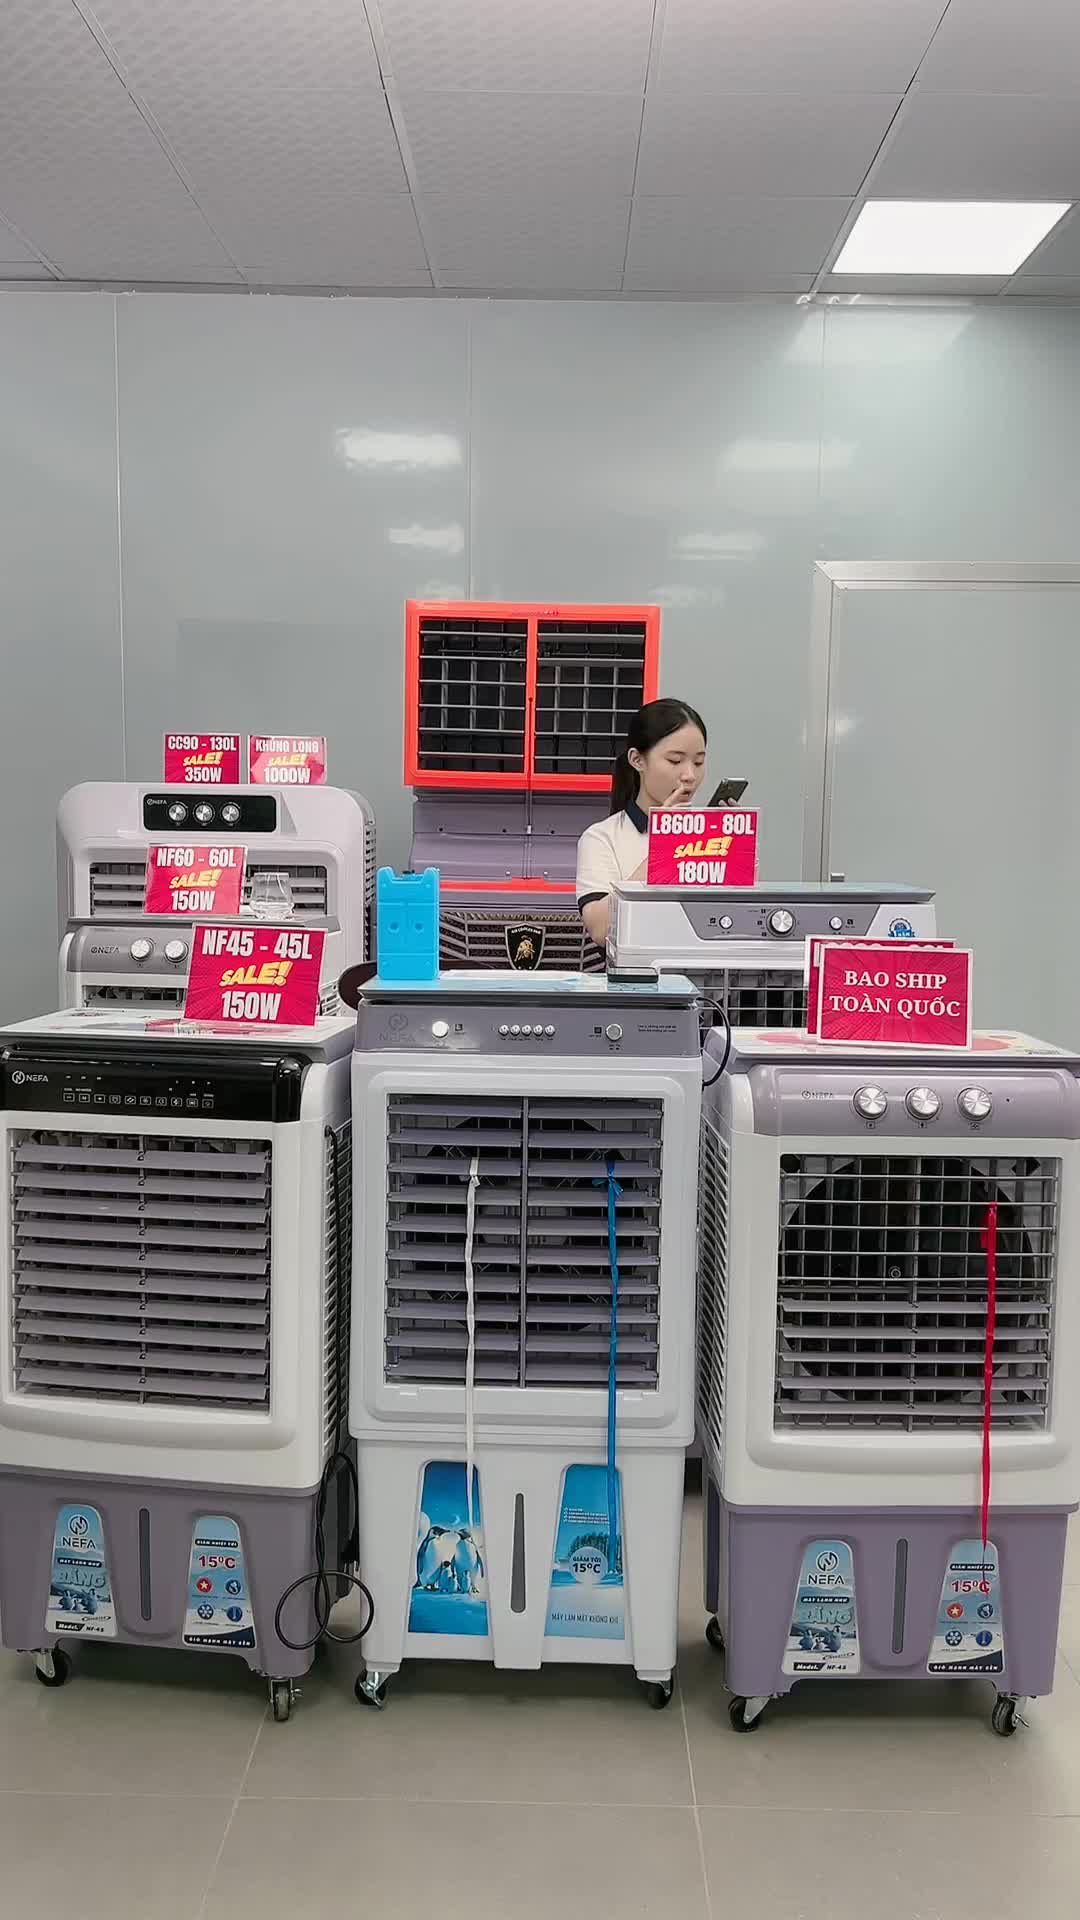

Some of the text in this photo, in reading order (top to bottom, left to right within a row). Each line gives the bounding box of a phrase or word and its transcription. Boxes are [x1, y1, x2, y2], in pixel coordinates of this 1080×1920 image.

[168, 736, 198, 750] CC90
[210, 736, 236, 751] 130L
[293, 741, 319, 753] LONG
[183, 751, 224, 766] SALE!
[185, 767, 222, 782] 350W
[264, 767, 311, 783] 1000W
[651, 813, 705, 835] L8600
[722, 813, 754, 835] 80L
[673, 836, 733, 858] SALE!
[157, 847, 194, 867] NF60
[208, 848, 236, 868] 60L
[169, 869, 222, 889] SALE!
[677, 861, 727, 884] 180W
[171, 890, 215, 911] 150W
[202, 929, 254, 956] NF45
[273, 933, 312, 960] 45L
[219, 960, 293, 987] SALE!
[843, 970, 947, 989] BAO SHIP
[221, 990, 281, 1021] 150W
[829, 993, 960, 1019] TOÀN QUỐC
[62, 1536, 96, 1549] NEFA
[808, 1574, 844, 1585] NEFA
